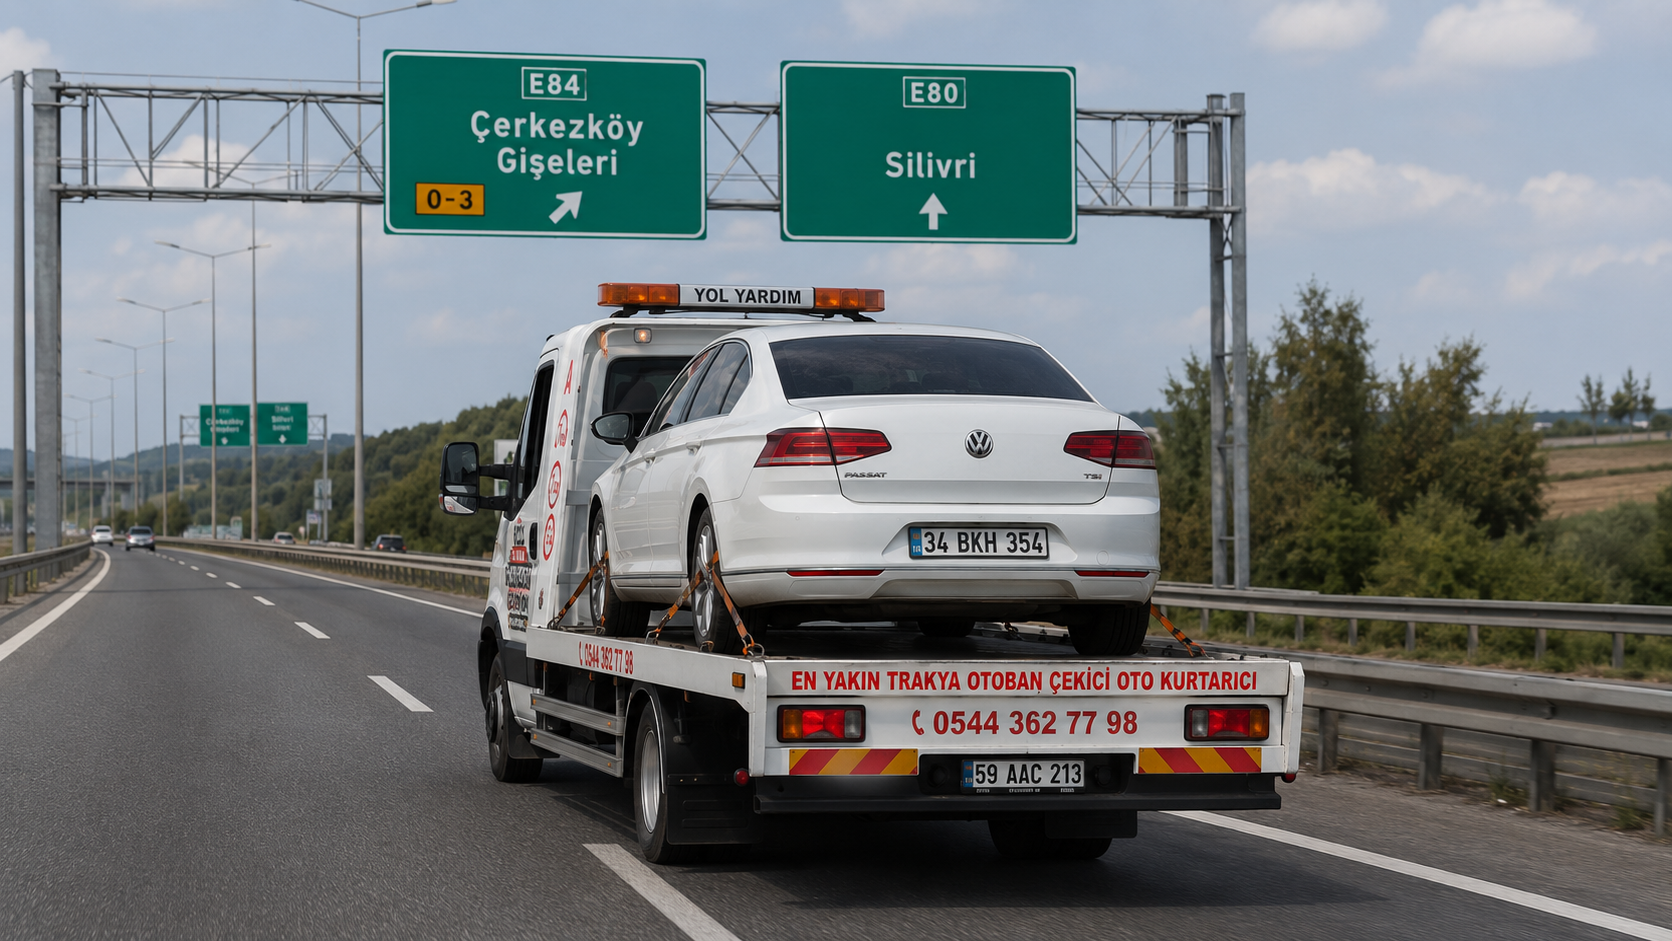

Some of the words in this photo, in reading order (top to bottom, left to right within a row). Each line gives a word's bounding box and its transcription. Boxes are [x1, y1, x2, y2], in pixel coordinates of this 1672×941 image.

[529, 73, 580, 95] E84
[911, 82, 958, 104] E80
[471, 110, 644, 147] Çerkezköy
[497, 146, 617, 181] Gişeleri
[885, 151, 976, 179] Silivri
[694, 288, 729, 303] YOL
[735, 288, 802, 305] YARDIM
[844, 471, 887, 479] PASSAT
[924, 531, 949, 553] 34
[957, 531, 997, 553] BKH
[1006, 531, 1043, 553] 354
[614, 648, 623, 673] 77
[625, 649, 634, 675] 98
[792, 671, 816, 690] EN
[824, 671, 880, 690] YAKIN
[887, 671, 961, 690] TRAKYA
[967, 671, 1042, 691] OTOBAN
[1049, 667, 1110, 694] ÇEKİCİ
[1117, 671, 1153, 690] OTO
[1160, 671, 1257, 690] KURTARICI
[933, 711, 999, 734] 0544
[1010, 711, 1056, 734] 362
[1067, 711, 1097, 734] 77
[1106, 711, 1138, 734] 98
[975, 764, 998, 784] 59
[1006, 764, 1042, 784] AAC
[1050, 764, 1081, 784] 213
